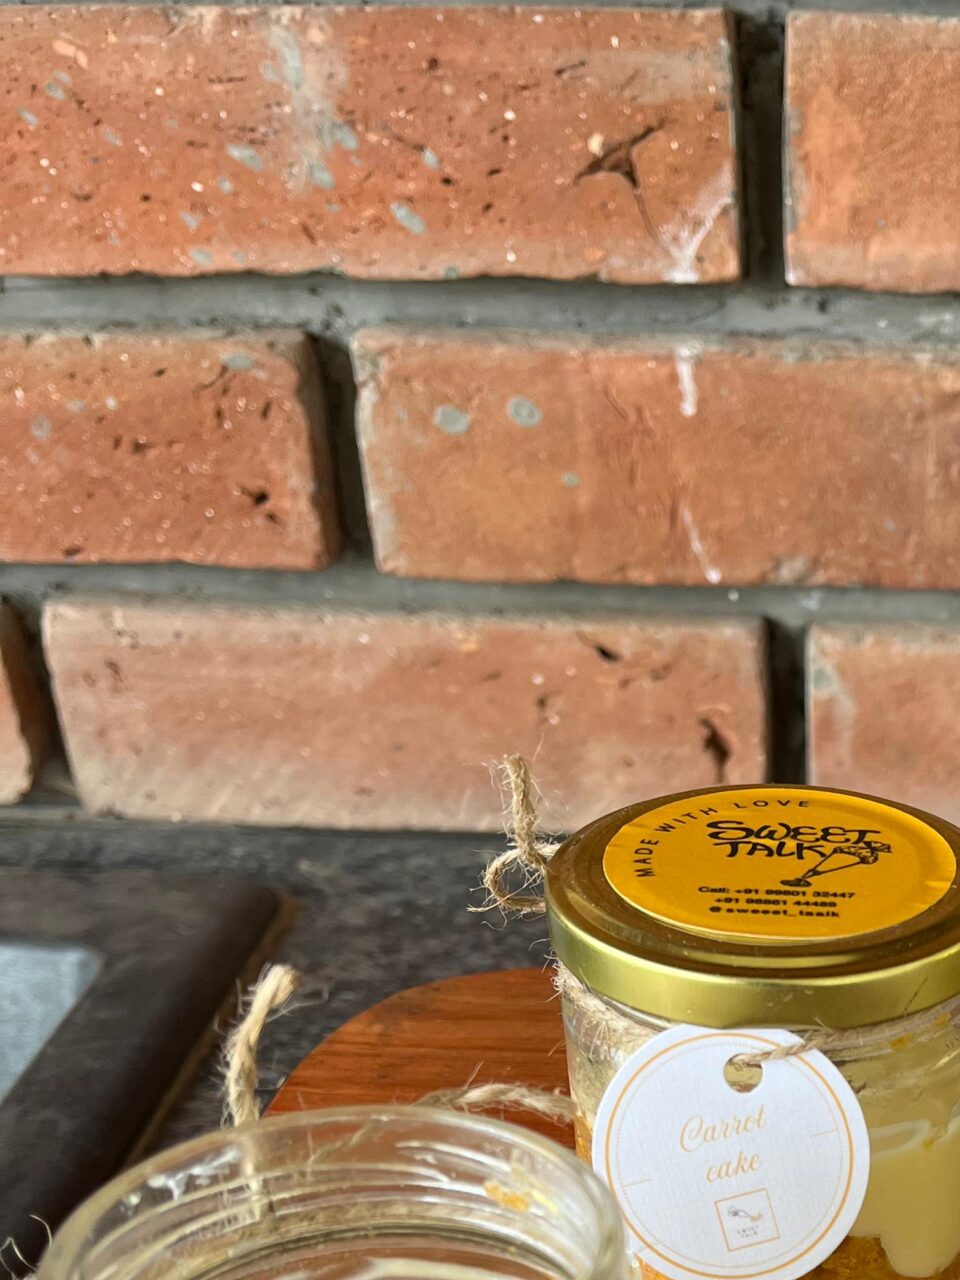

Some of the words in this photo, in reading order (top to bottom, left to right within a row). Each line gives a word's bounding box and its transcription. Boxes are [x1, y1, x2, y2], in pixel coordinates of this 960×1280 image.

[632, 838, 660, 879] MADE
[654, 806, 718, 833] WITH
[734, 799, 810, 809] LOVE
[706, 820, 883, 846] SWEET
[713, 840, 828, 860] TALK
[699, 886, 730, 894] Call:
[678, 1103, 767, 1152] Carrot
[705, 1150, 763, 1184] cake
